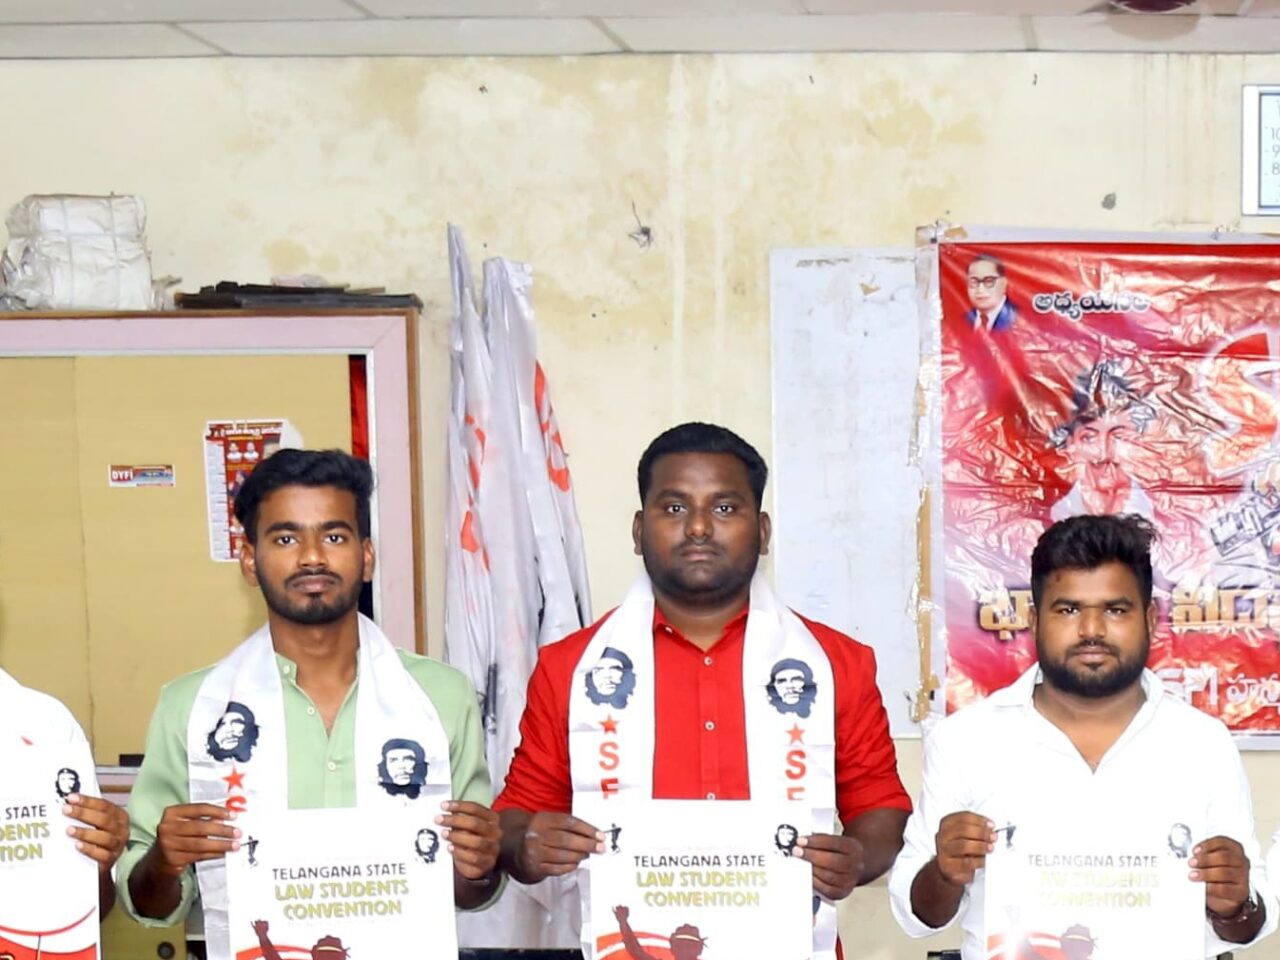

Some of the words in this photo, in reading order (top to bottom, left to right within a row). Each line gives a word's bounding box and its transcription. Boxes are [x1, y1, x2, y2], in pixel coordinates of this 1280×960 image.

[1272, 144, 1280, 158] 9
[1272, 162, 1280, 176] 8
[5, 805, 47, 820] STATE
[634, 855, 720, 867] TELANGANA
[726, 855, 765, 867] STATE
[1028, 854, 1113, 867] TELANGANA
[1119, 855, 1157, 867] STATE
[272, 865, 361, 880] TELANGANA
[366, 863, 406, 877] STATE
[636, 871, 674, 888] LAW
[680, 871, 768, 888] STUDENTS
[275, 884, 313, 901] LAW
[319, 880, 409, 898] STUDENTS
[644, 891, 759, 907] CONVENTION
[283, 900, 402, 920] CONVENTION
